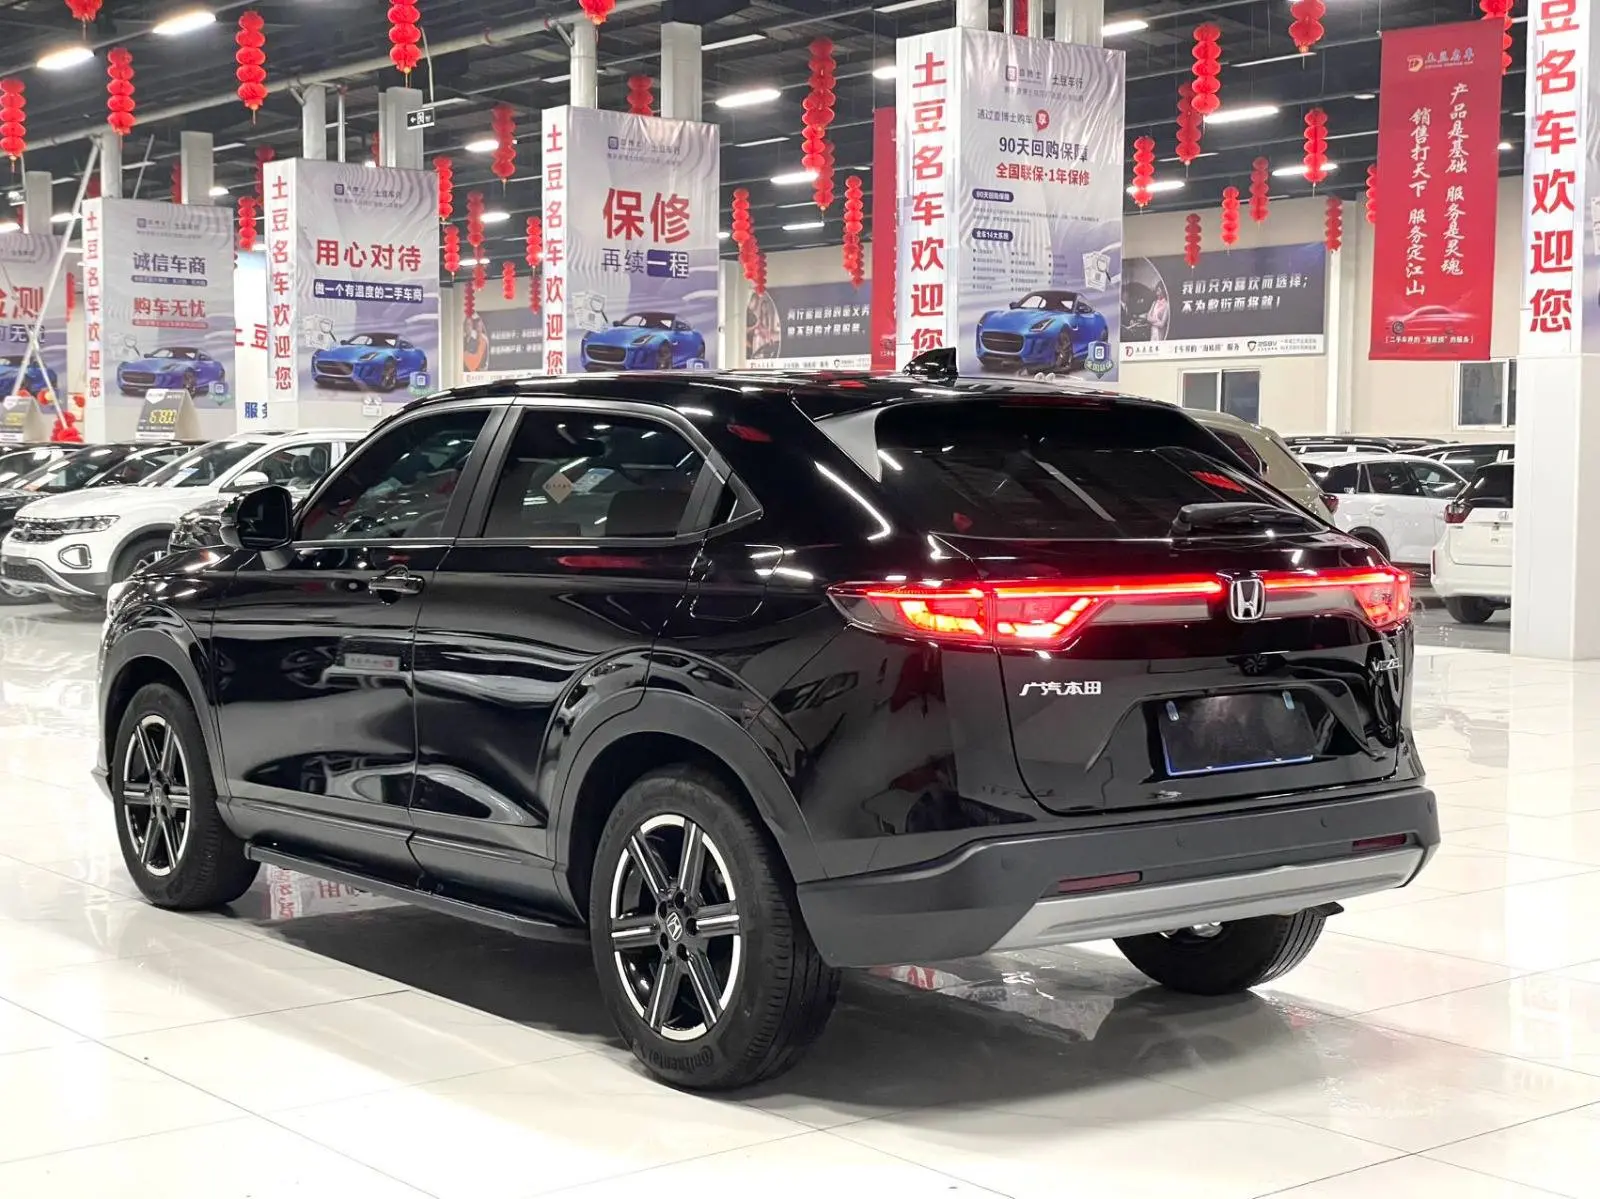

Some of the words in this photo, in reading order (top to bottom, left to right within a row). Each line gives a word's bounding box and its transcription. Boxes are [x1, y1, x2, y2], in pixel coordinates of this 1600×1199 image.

[1445, 83, 1469, 174] 产品是基础
[999, 137, 1088, 162] 90天回购保障
[995, 162, 1090, 186] 全国联保·1年保修
[603, 188, 690, 244] 保修
[911, 52, 947, 358] 土豆名车欢迎您
[1440, 186, 1467, 276] 服务是灵魂
[133, 252, 206, 275] 诚信车商
[316, 239, 422, 272] 用心对待
[545, 124, 564, 375] 土豆名车欢迎您
[601, 248, 689, 278] 再续一程
[1405, 208, 1428, 296] 服务定江山
[271, 176, 292, 390] 土豆名车欢迎您
[315, 281, 423, 302] 做一个有温度的二手车商
[0, 286, 44, 320] 测
[86, 211, 102, 398] 土豆名车欢迎您
[133, 297, 206, 317] 购车无忧
[1019, 681, 1101, 696] 广汽本田
